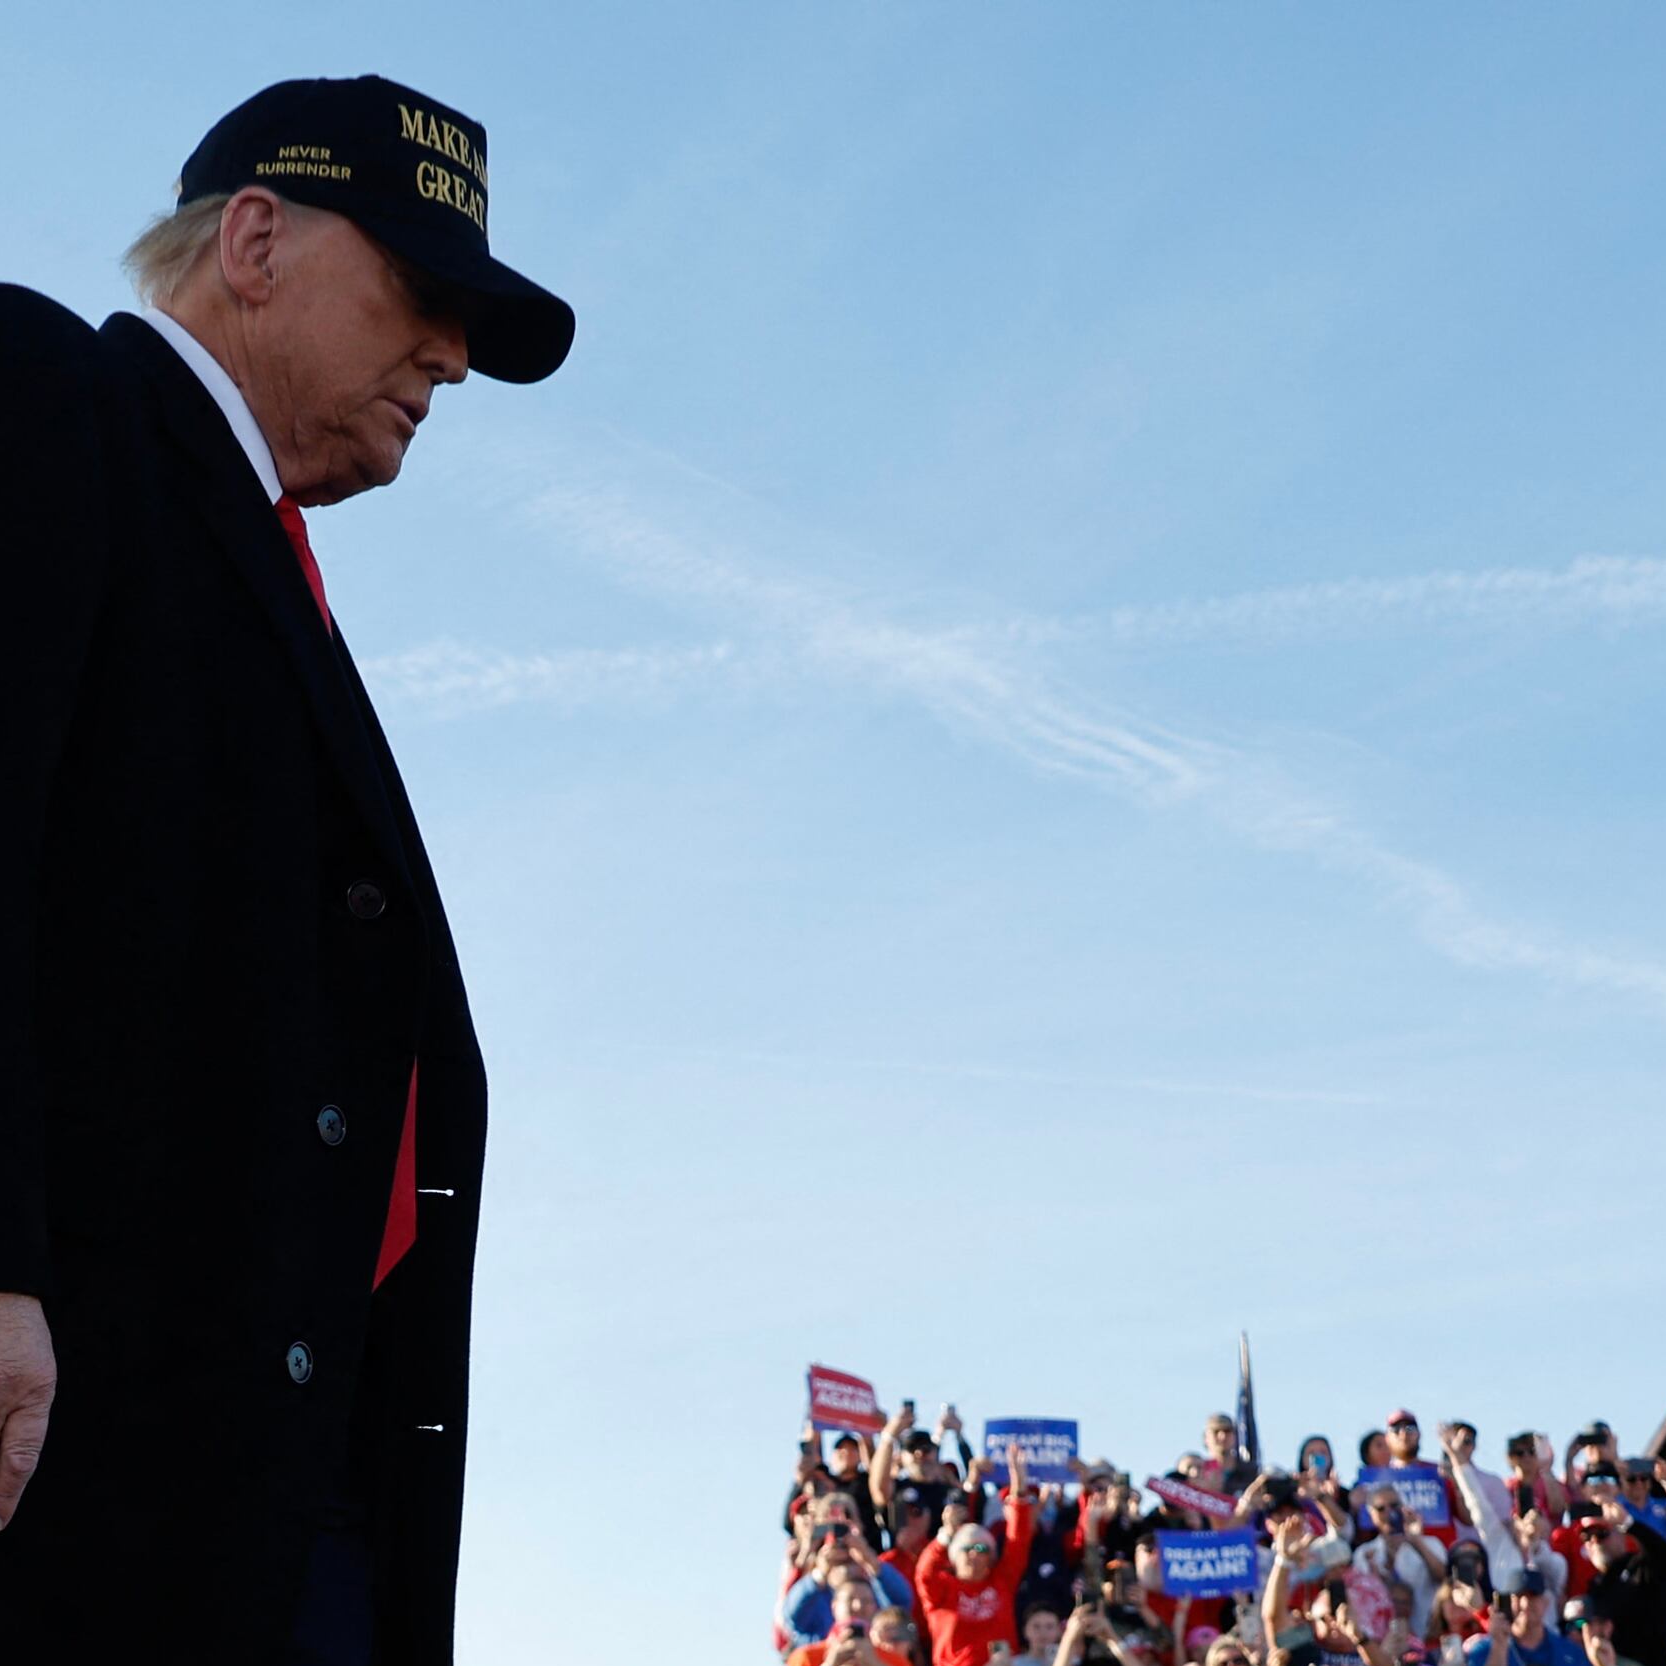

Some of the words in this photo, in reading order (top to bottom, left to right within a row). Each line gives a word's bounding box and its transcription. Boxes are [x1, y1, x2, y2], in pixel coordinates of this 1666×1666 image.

[397, 103, 472, 170] MAKE
[278, 145, 331, 161] NEVER
[255, 162, 352, 181] SURRENDER
[416, 161, 486, 232] GREAT
[991, 1447, 1069, 1466] AAIN!
[1163, 1548, 1218, 1561] DREAM
[1220, 1545, 1253, 1559] BIG,
[1168, 1557, 1248, 1581] AGAIN!
